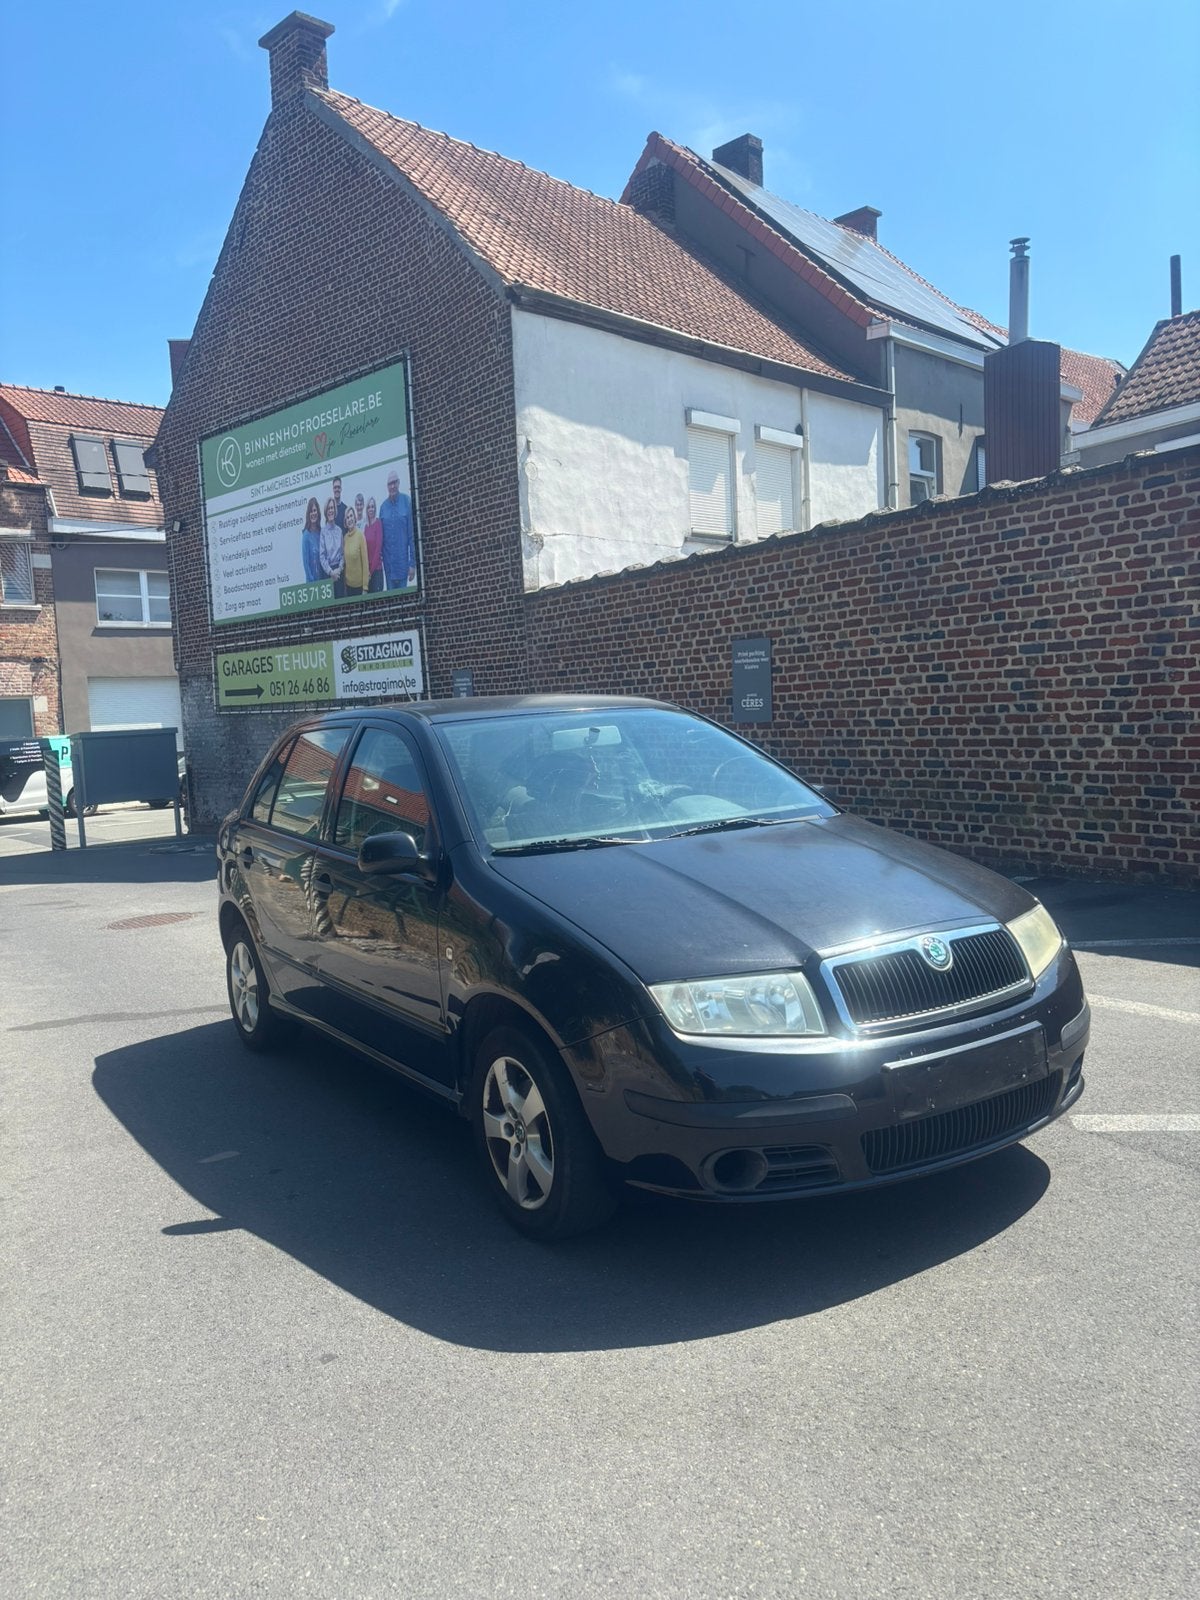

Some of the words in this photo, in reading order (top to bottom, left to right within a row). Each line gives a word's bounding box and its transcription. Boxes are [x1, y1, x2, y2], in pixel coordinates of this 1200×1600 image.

[244, 391, 383, 456] BINNENHOFROESELARE.BE
[246, 455, 265, 469] wonen
[265, 451, 278, 466] met
[278, 441, 307, 461] diensten
[250, 465, 323, 498] SINT-MICHIELSSTRAAT
[323, 463, 332, 475] 32
[218, 517, 239, 529] Rustige
[239, 508, 274, 524] zuidgerichte
[274, 497, 308, 512] binnentuin
[219, 530, 252, 546] Serviceflats
[252, 527, 264, 537] met
[264, 523, 277, 534] veel
[277, 516, 304, 530] diensten
[221, 548, 250, 562] Vriendelijk
[251, 542, 273, 557] onthaal
[222, 567, 235, 578] Veel
[235, 562, 268, 574] activiteiten
[223, 580, 264, 595] Boodschappen
[264, 577, 276, 586] aan
[276, 573, 290, 583] huis
[224, 602, 237, 613] Zorg
[238, 601, 245, 610] op
[246, 597, 262, 607] maat
[281, 591, 296, 607] 051
[297, 588, 309, 603] 35
[309, 586, 319, 602] 71
[321, 584, 332, 600] 35
[357, 640, 412, 661] STRAGIMO
[222, 655, 274, 678] GARAGES
[275, 654, 291, 673] TE
[293, 649, 327, 671] HUUR
[269, 681, 286, 697] 051
[285, 680, 300, 695] 26
[302, 678, 316, 694] 46
[316, 677, 330, 693] 86
[342, 675, 417, 695] info@stragimo.be
[741, 697, 764, 707] CÉRES
[61, 745, 69, 761] P
